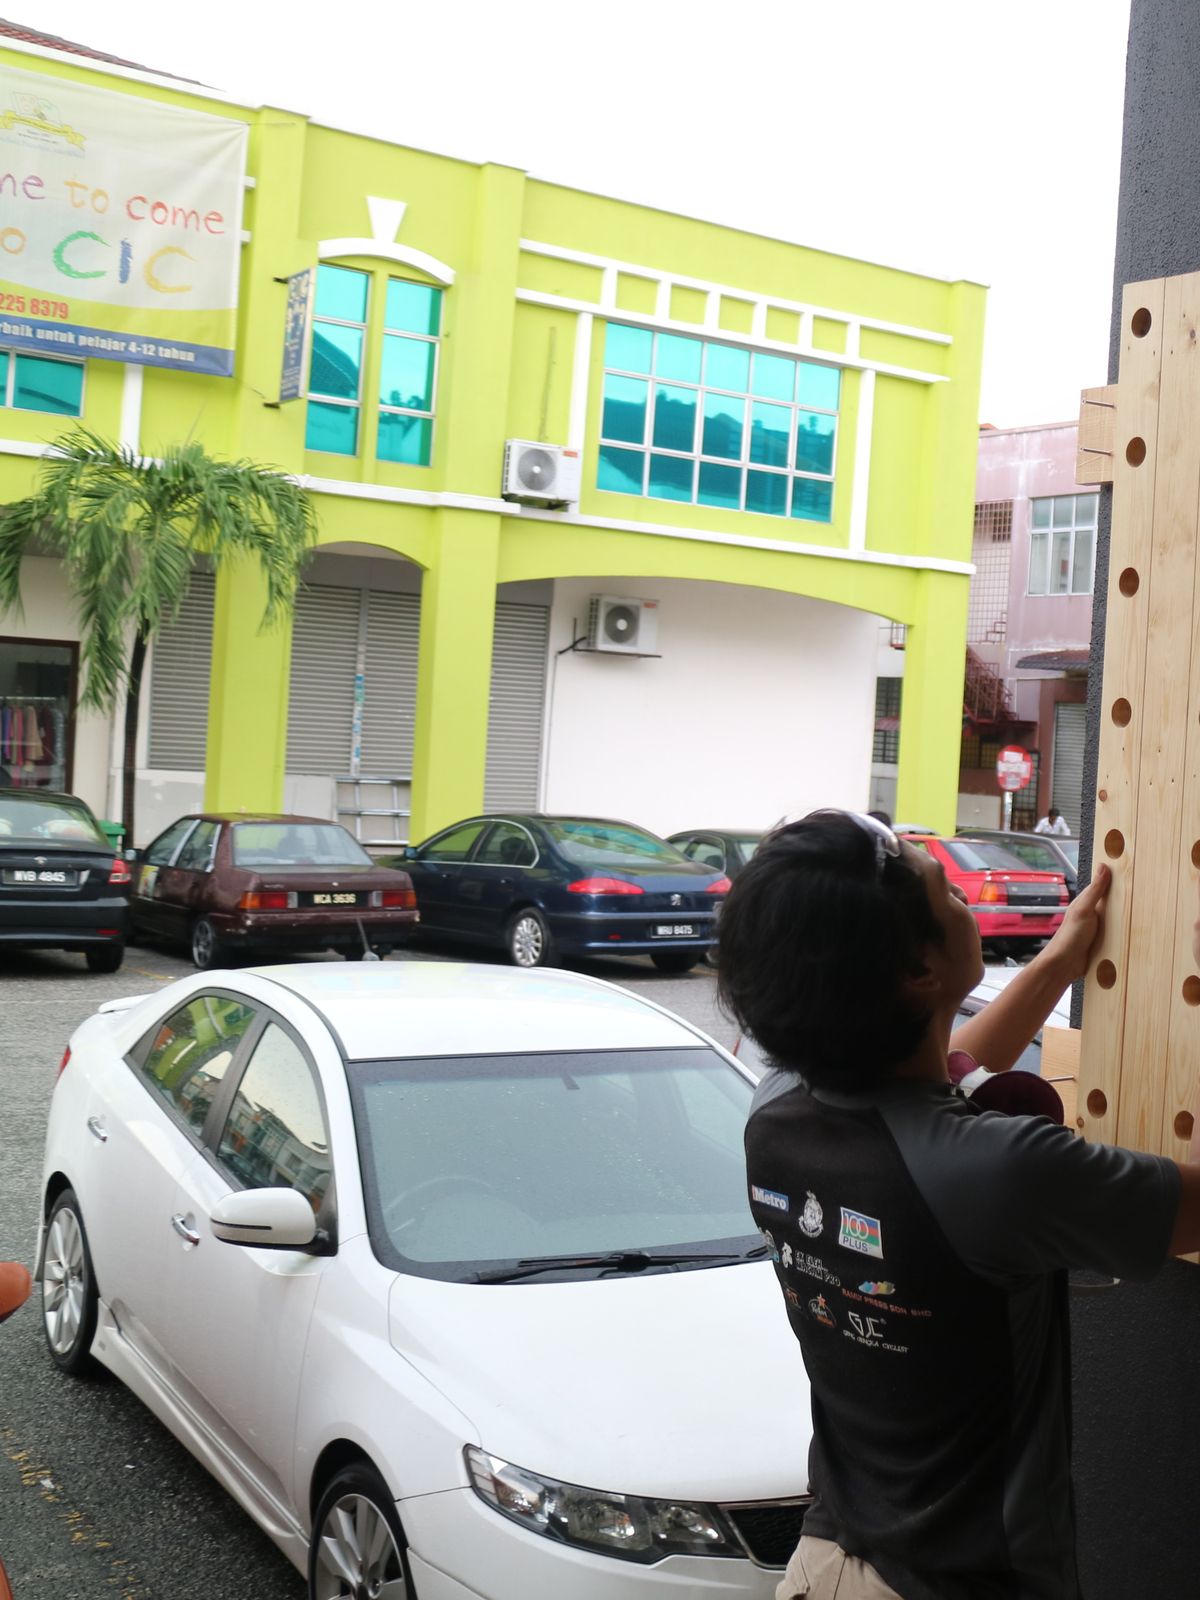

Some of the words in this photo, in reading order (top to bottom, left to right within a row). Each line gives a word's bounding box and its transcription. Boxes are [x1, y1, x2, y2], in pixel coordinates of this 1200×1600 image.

[63, 181, 110, 214] to
[126, 195, 225, 234] come
[53, 230, 197, 293] CIC
[30, 298, 69, 319] 8379
[36, 328, 76, 344] untuk
[78, 335, 126, 352] pelajar
[128, 341, 156, 357] 4-12
[158, 346, 195, 362] tahun
[753, 1186, 787, 1210] Metro
[844, 1212, 869, 1239] 100
[843, 1236, 868, 1252] PLUS
